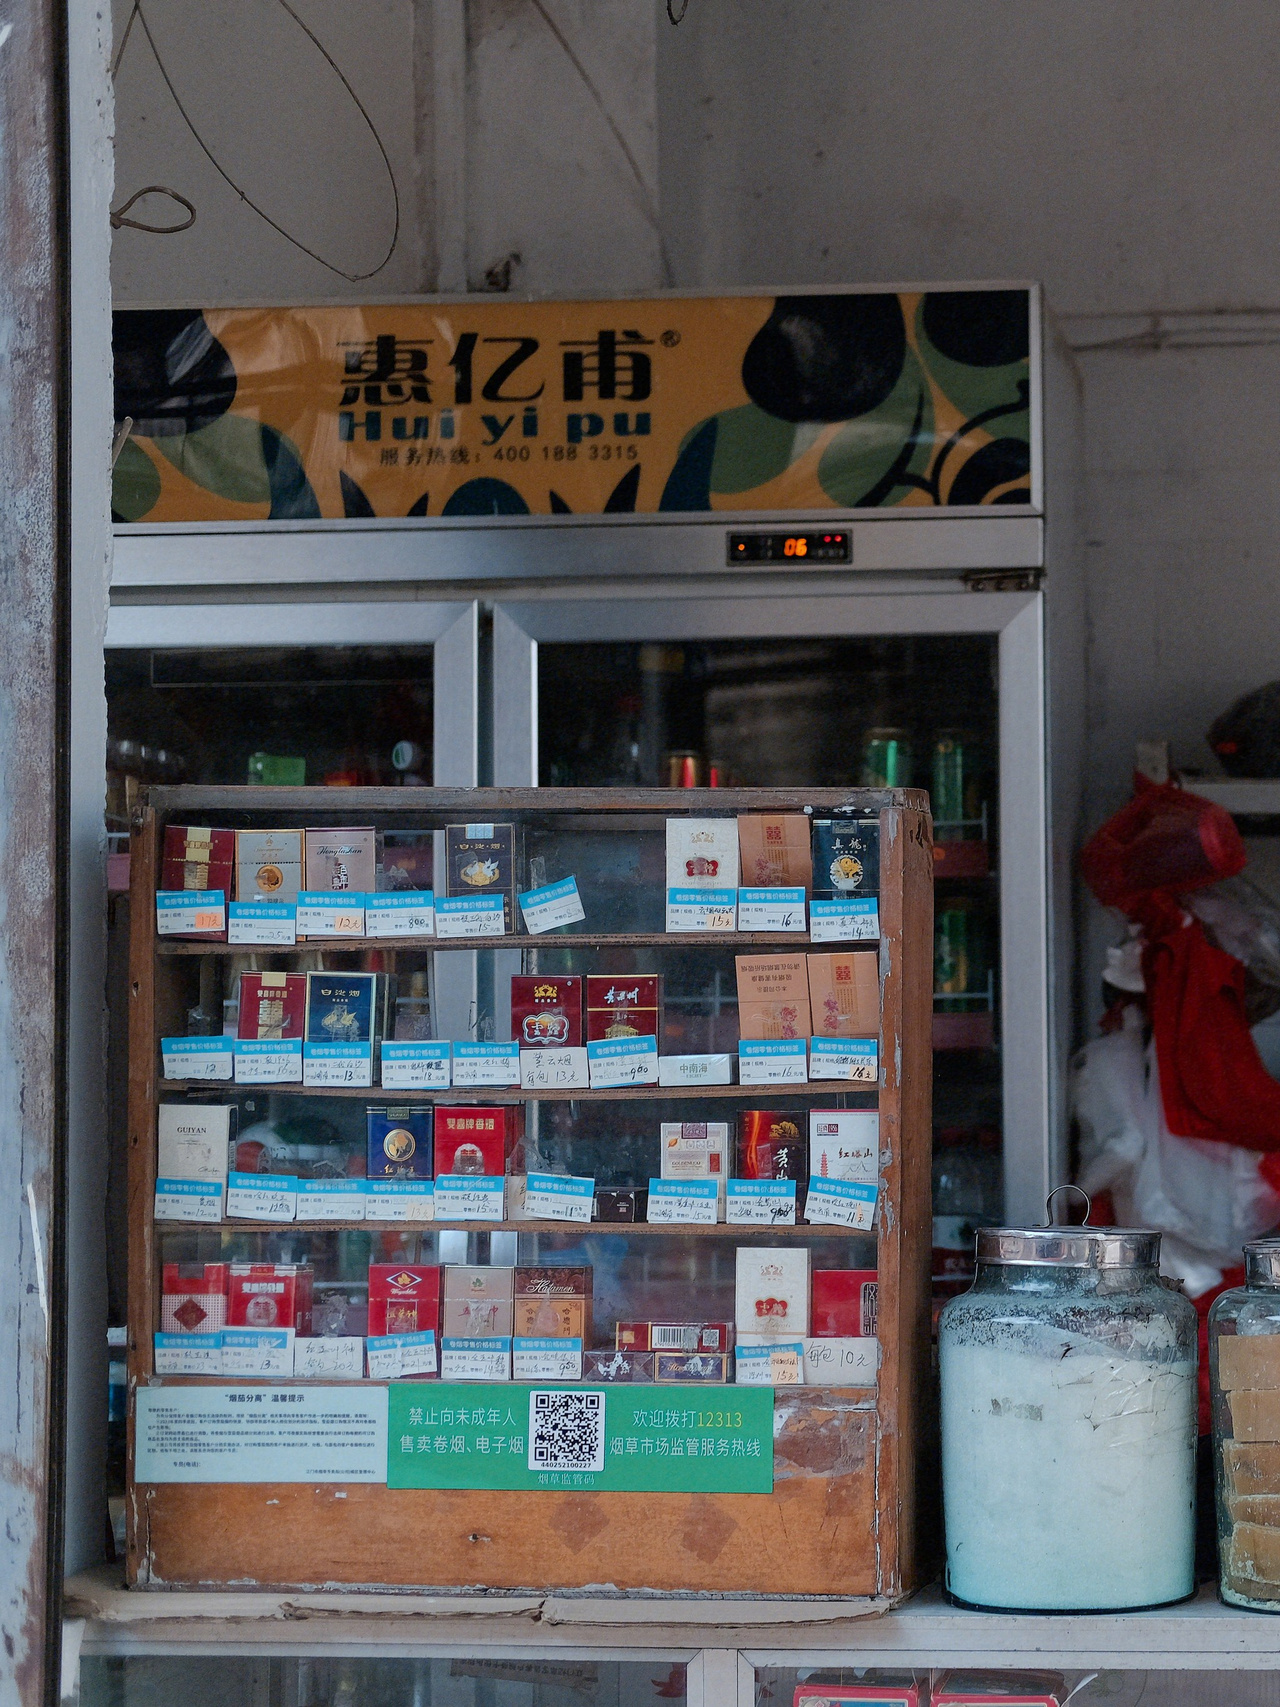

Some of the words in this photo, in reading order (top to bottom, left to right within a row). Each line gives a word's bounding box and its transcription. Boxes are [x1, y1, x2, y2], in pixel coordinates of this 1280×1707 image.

[337, 330, 655, 406] 惠亿甫
[339, 407, 455, 442] Hui
[481, 406, 539, 446] yi
[566, 412, 651, 444] pu
[493, 445, 531, 462] 400
[588, 444, 638, 460] 3315
[784, 538, 807, 556] 06
[680, 1064, 708, 1073] 中南海
[782, 1066, 792, 1078] 16
[839, 1148, 873, 1159] 红塔山
[526, 1280, 575, 1294] Hatamen
[271, 1394, 305, 1403] 温馨提示
[409, 1407, 517, 1426] 禁止向未成年人
[400, 1435, 525, 1454] 售卖卷烟、电子烟
[609, 1437, 761, 1457] 烟草市场监管服务热线
[538, 1473, 596, 1485] 烟草监管码
